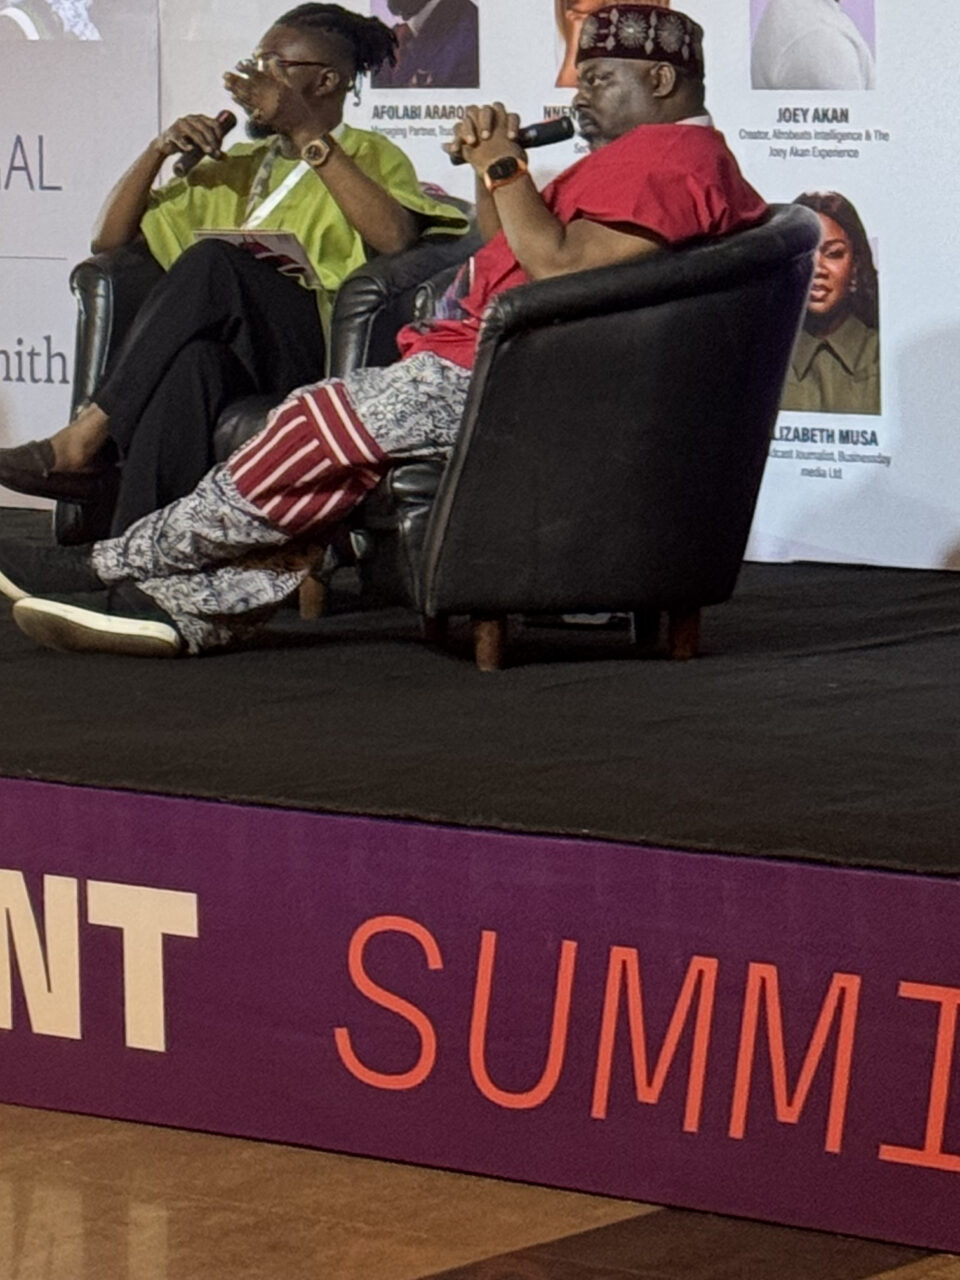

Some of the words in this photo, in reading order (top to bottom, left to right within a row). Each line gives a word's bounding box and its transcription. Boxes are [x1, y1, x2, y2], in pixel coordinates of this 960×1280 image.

[372, 105, 421, 120] AFOLABI
[777, 107, 810, 124] JOEY
[812, 107, 849, 124] AKAN
[874, 130, 890, 141] The
[769, 146, 787, 159] Joey
[789, 146, 810, 157] Akan
[812, 146, 859, 159] Experience
[839, 429, 879, 446] MUSA
[334, 915, 960, 1173] SUMMI
